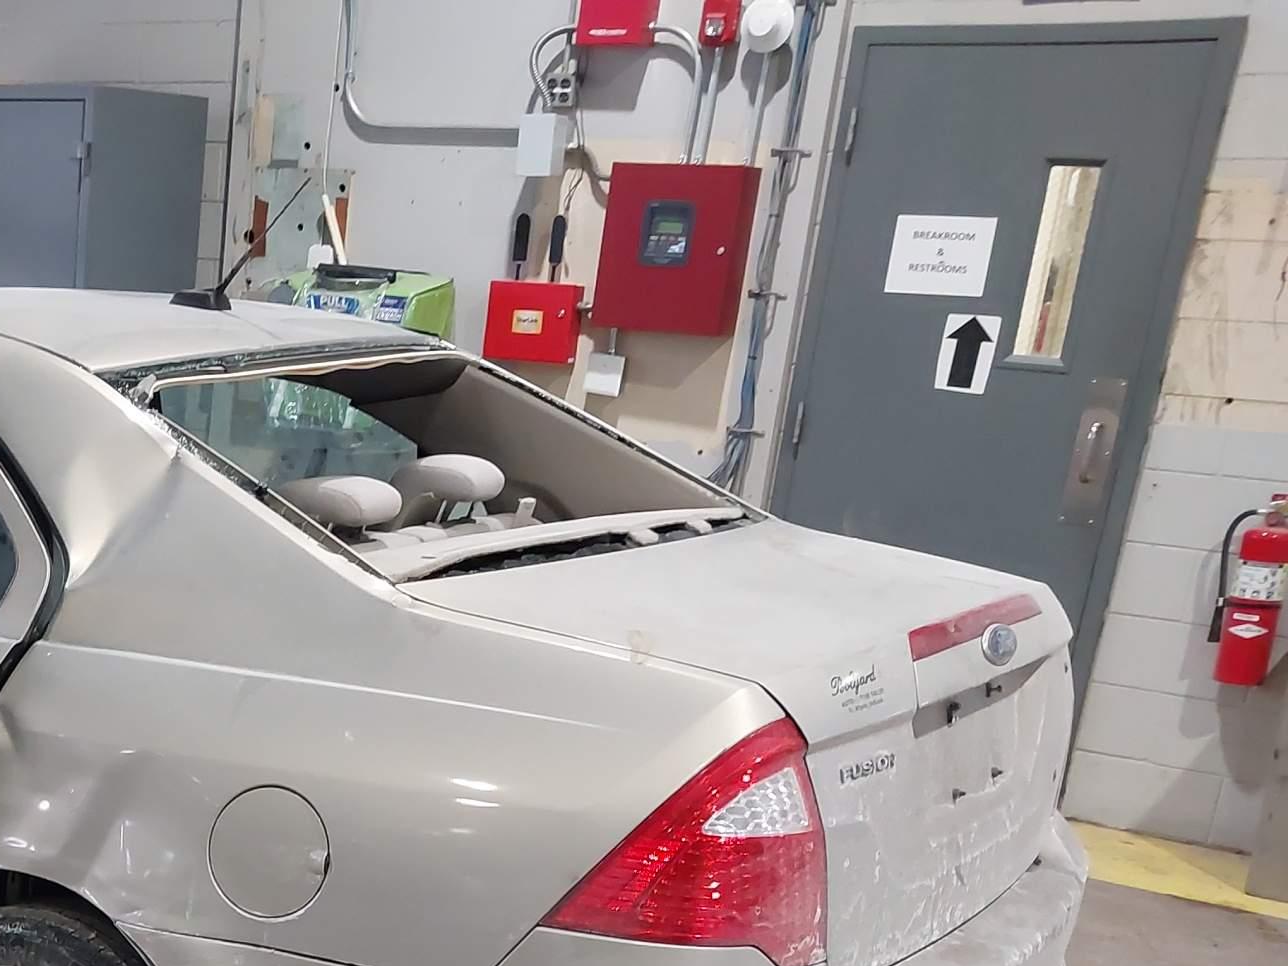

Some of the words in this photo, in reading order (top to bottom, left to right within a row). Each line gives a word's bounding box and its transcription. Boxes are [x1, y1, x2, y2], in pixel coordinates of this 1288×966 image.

[912, 230, 976, 241] BREAKROOM
[936, 247, 945, 257] &
[907, 262, 968, 274] RESTROOMS
